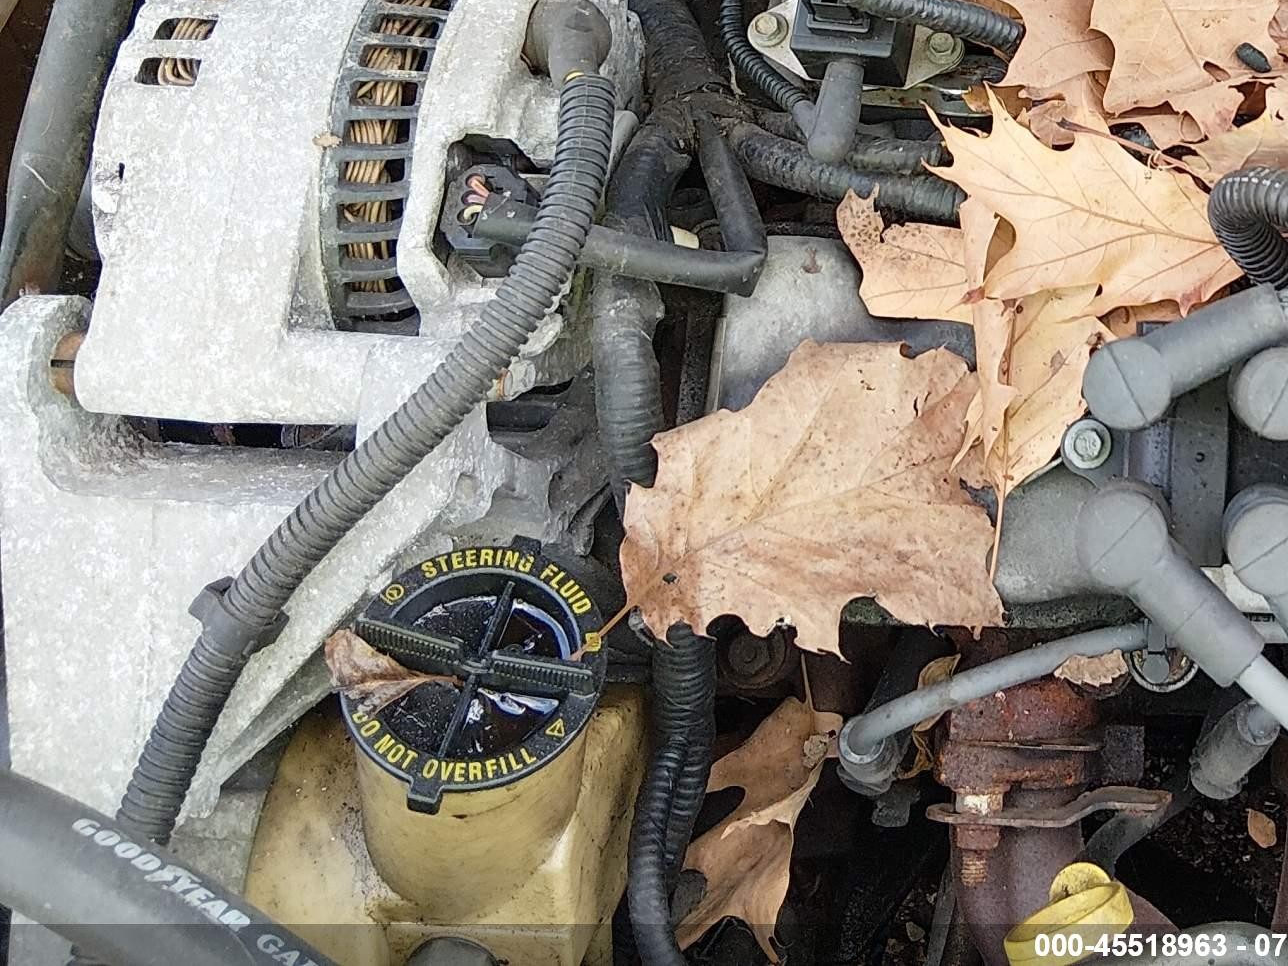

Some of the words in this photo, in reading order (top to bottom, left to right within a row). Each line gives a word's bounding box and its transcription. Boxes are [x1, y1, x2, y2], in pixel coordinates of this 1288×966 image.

[420, 548, 536, 579] STEERING
[539, 564, 593, 615] FLUID
[373, 734, 419, 770] NOT
[422, 747, 538, 782] OVERFILL
[71, 818, 251, 933] GOODYEAR
